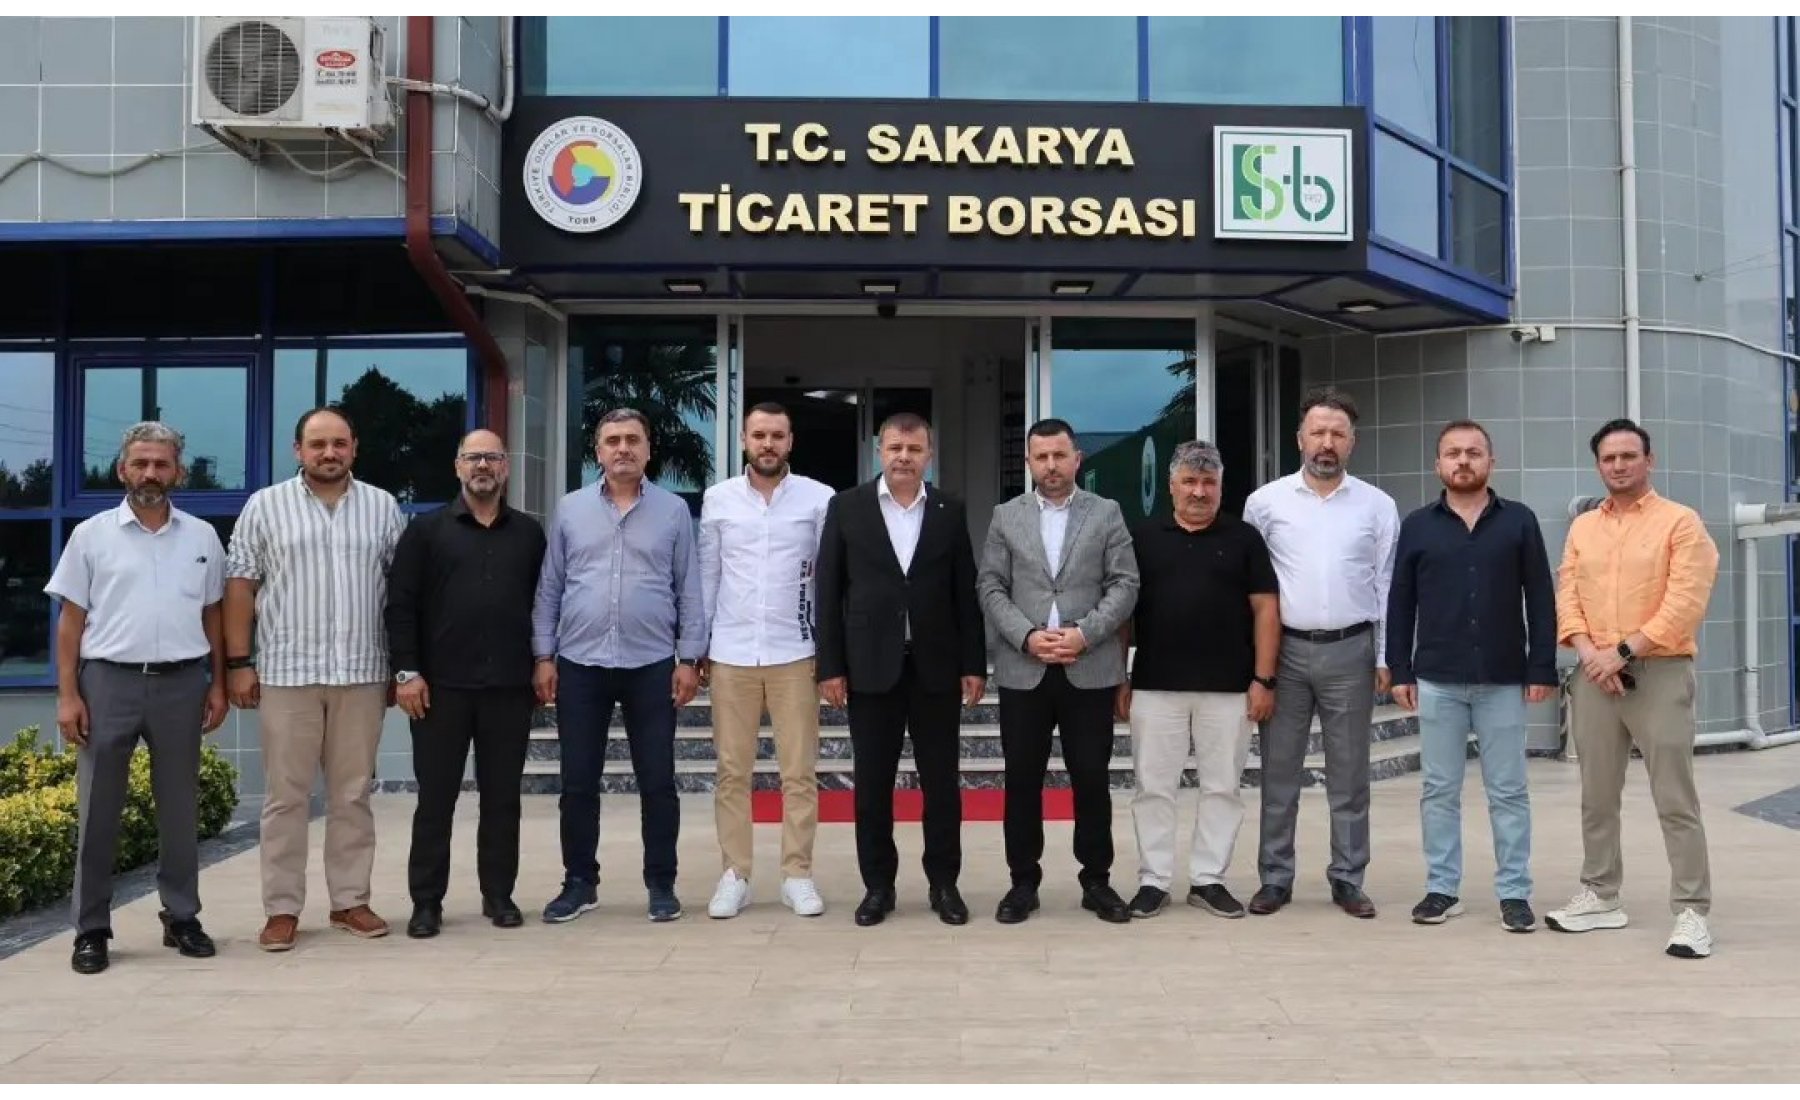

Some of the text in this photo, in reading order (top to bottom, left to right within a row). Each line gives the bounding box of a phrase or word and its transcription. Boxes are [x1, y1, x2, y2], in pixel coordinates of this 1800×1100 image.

[745, 123, 1134, 166] T.C. SAKARYA
[679, 184, 1196, 237] TİCARET BORSASI
